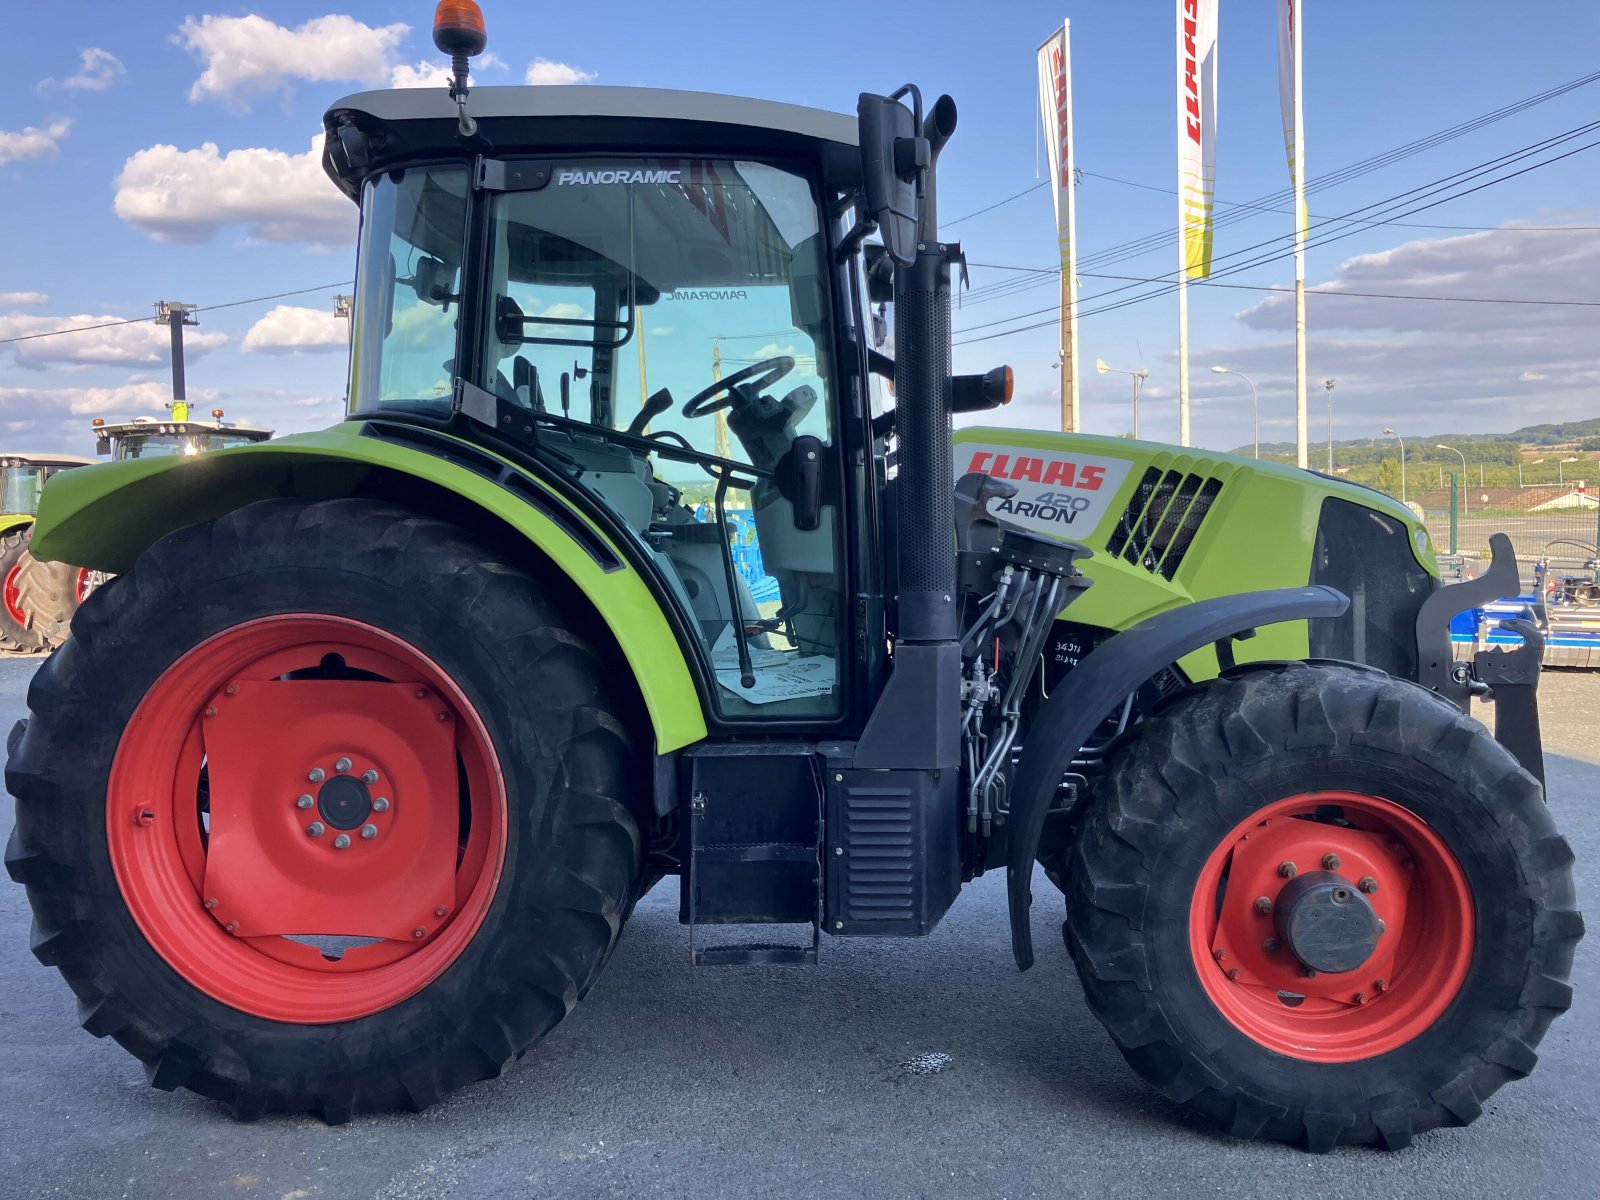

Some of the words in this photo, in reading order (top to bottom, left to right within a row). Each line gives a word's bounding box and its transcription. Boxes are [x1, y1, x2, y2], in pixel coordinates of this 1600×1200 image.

[558, 170, 681, 186] PANORAMIC
[967, 452, 1107, 491] CLAAS
[994, 499, 1078, 525] ARION
[1035, 491, 1090, 512] 420
